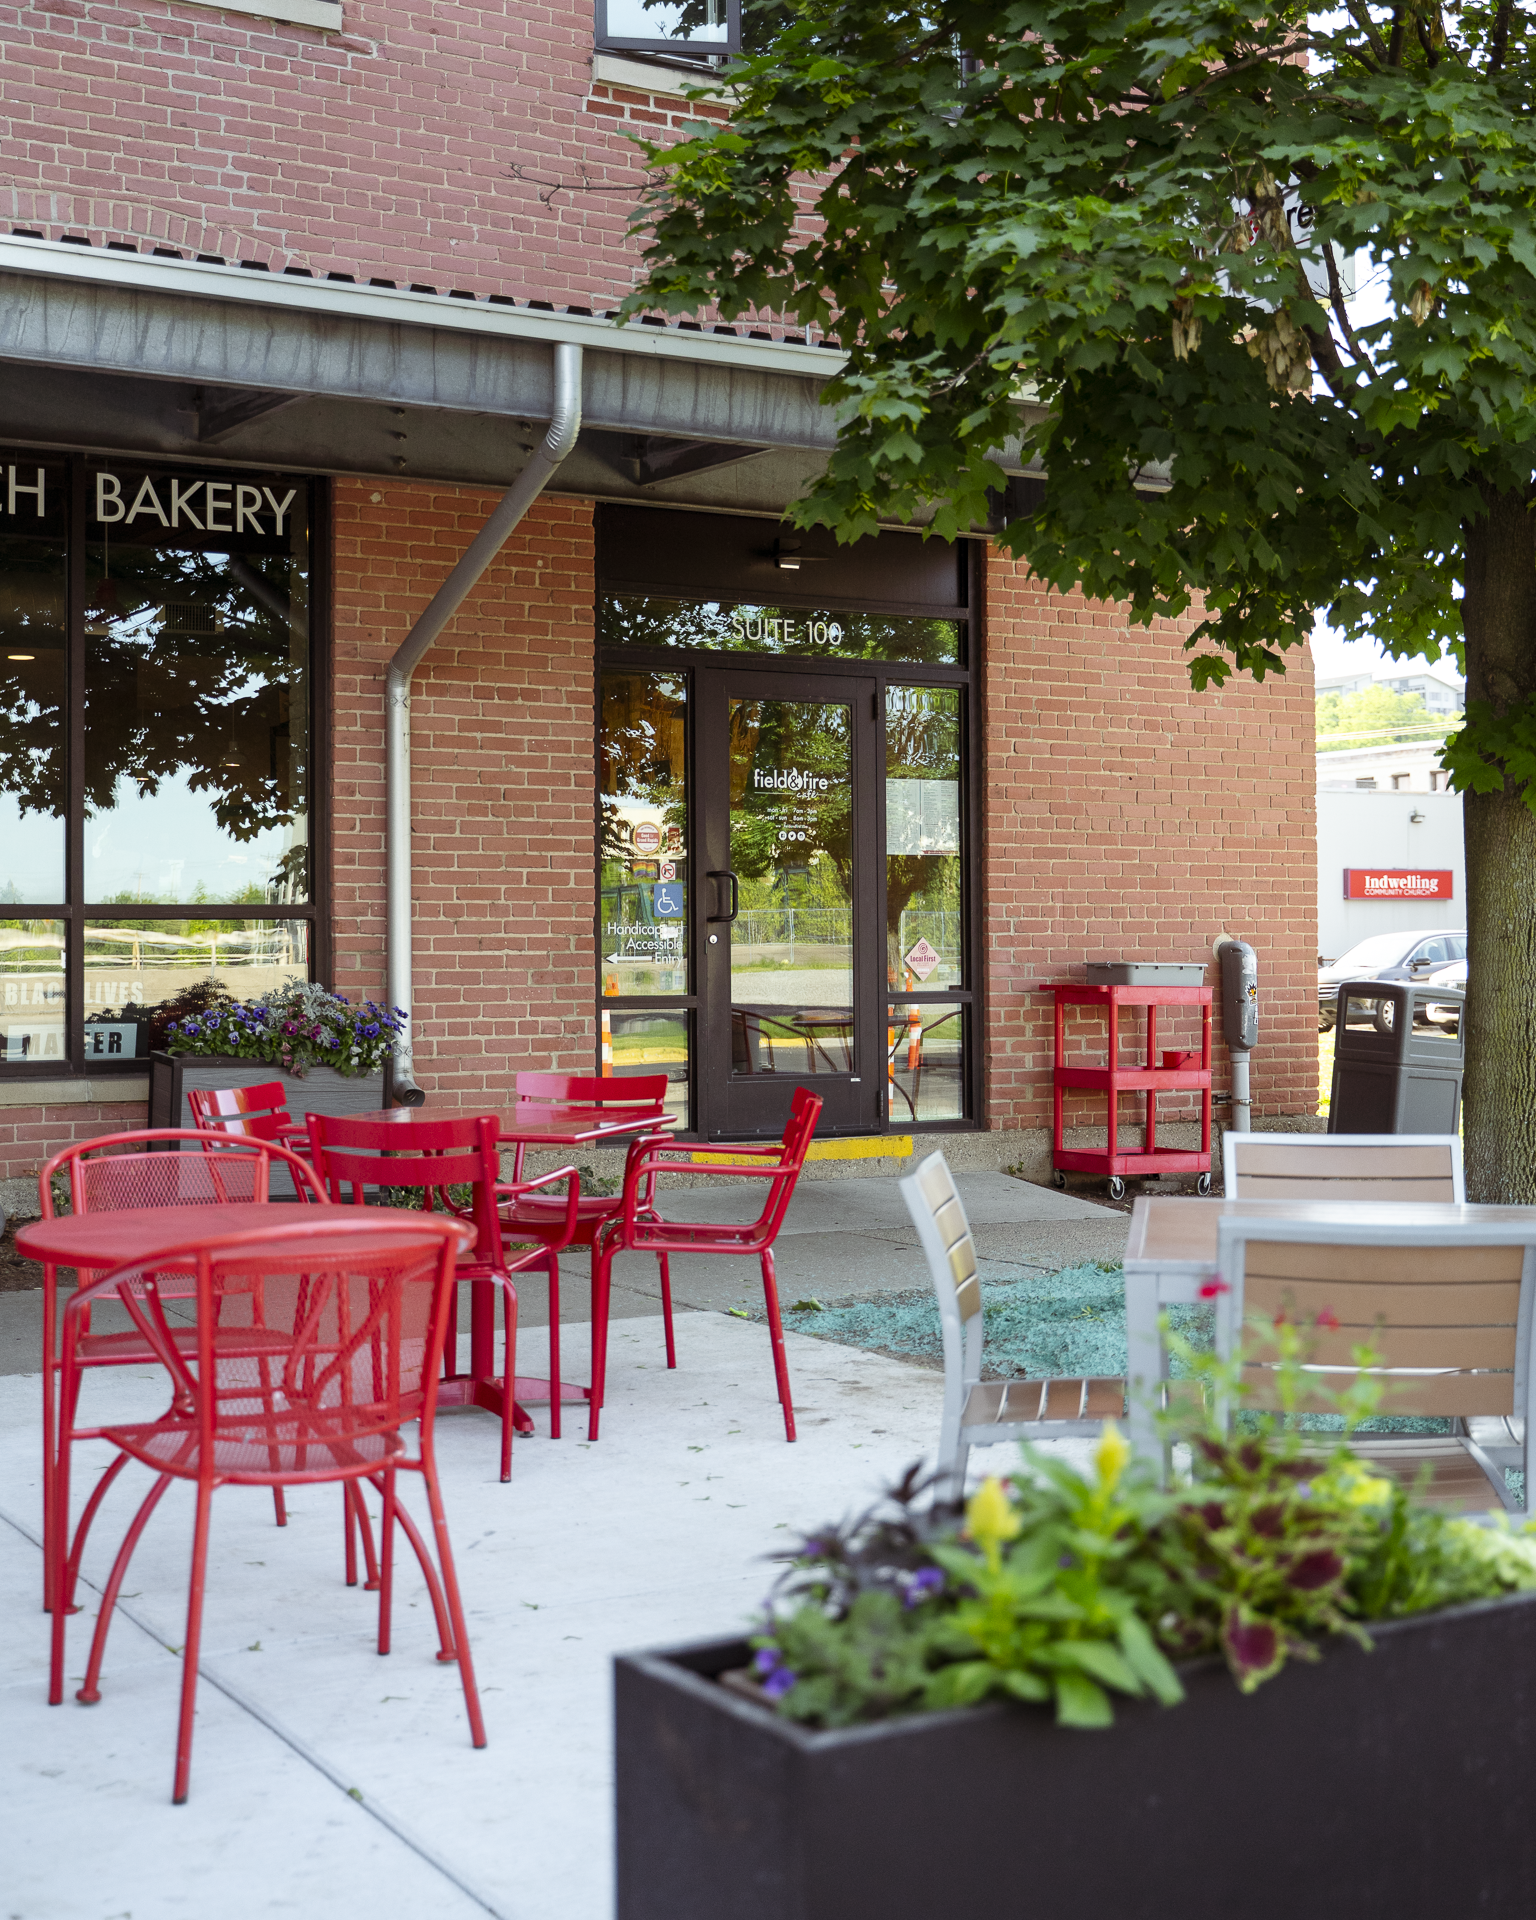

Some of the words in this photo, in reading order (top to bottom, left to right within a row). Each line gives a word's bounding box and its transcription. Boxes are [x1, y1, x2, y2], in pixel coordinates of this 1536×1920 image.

[0, 465, 45, 517] H
[97, 472, 297, 536] BAKERY
[732, 616, 795, 642] SUITE
[806, 621, 842, 645] 100
[1364, 875, 1439, 892] Indwelling
[607, 920, 684, 938] Handicapd
[626, 937, 684, 949] Accessible
[655, 951, 684, 968] Entry
[5, 982, 62, 1005] BLAC
[84, 981, 144, 1005] LIVES
